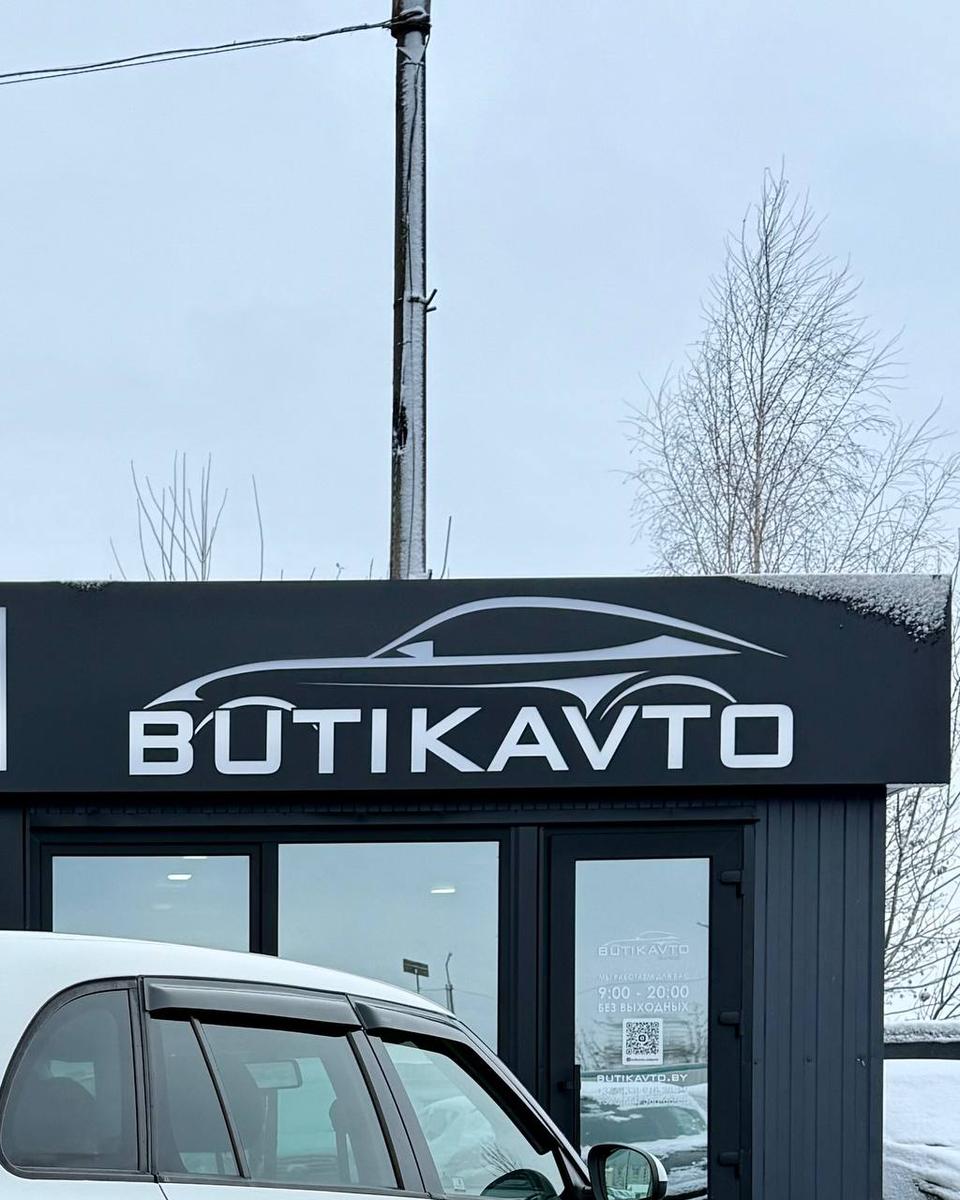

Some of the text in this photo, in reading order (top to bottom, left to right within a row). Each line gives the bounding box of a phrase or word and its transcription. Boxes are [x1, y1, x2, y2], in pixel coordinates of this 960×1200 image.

[128, 703, 795, 776] BUTIKAVTO
[598, 944, 689, 956] BUTIKAVTO
[598, 986, 630, 999] 9:00
[647, 985, 689, 999] 20:00
[598, 1002, 688, 1013] БЕЗ ВЫХОДНЫХ
[596, 1074, 688, 1082] BUTIKAVTO.BY
